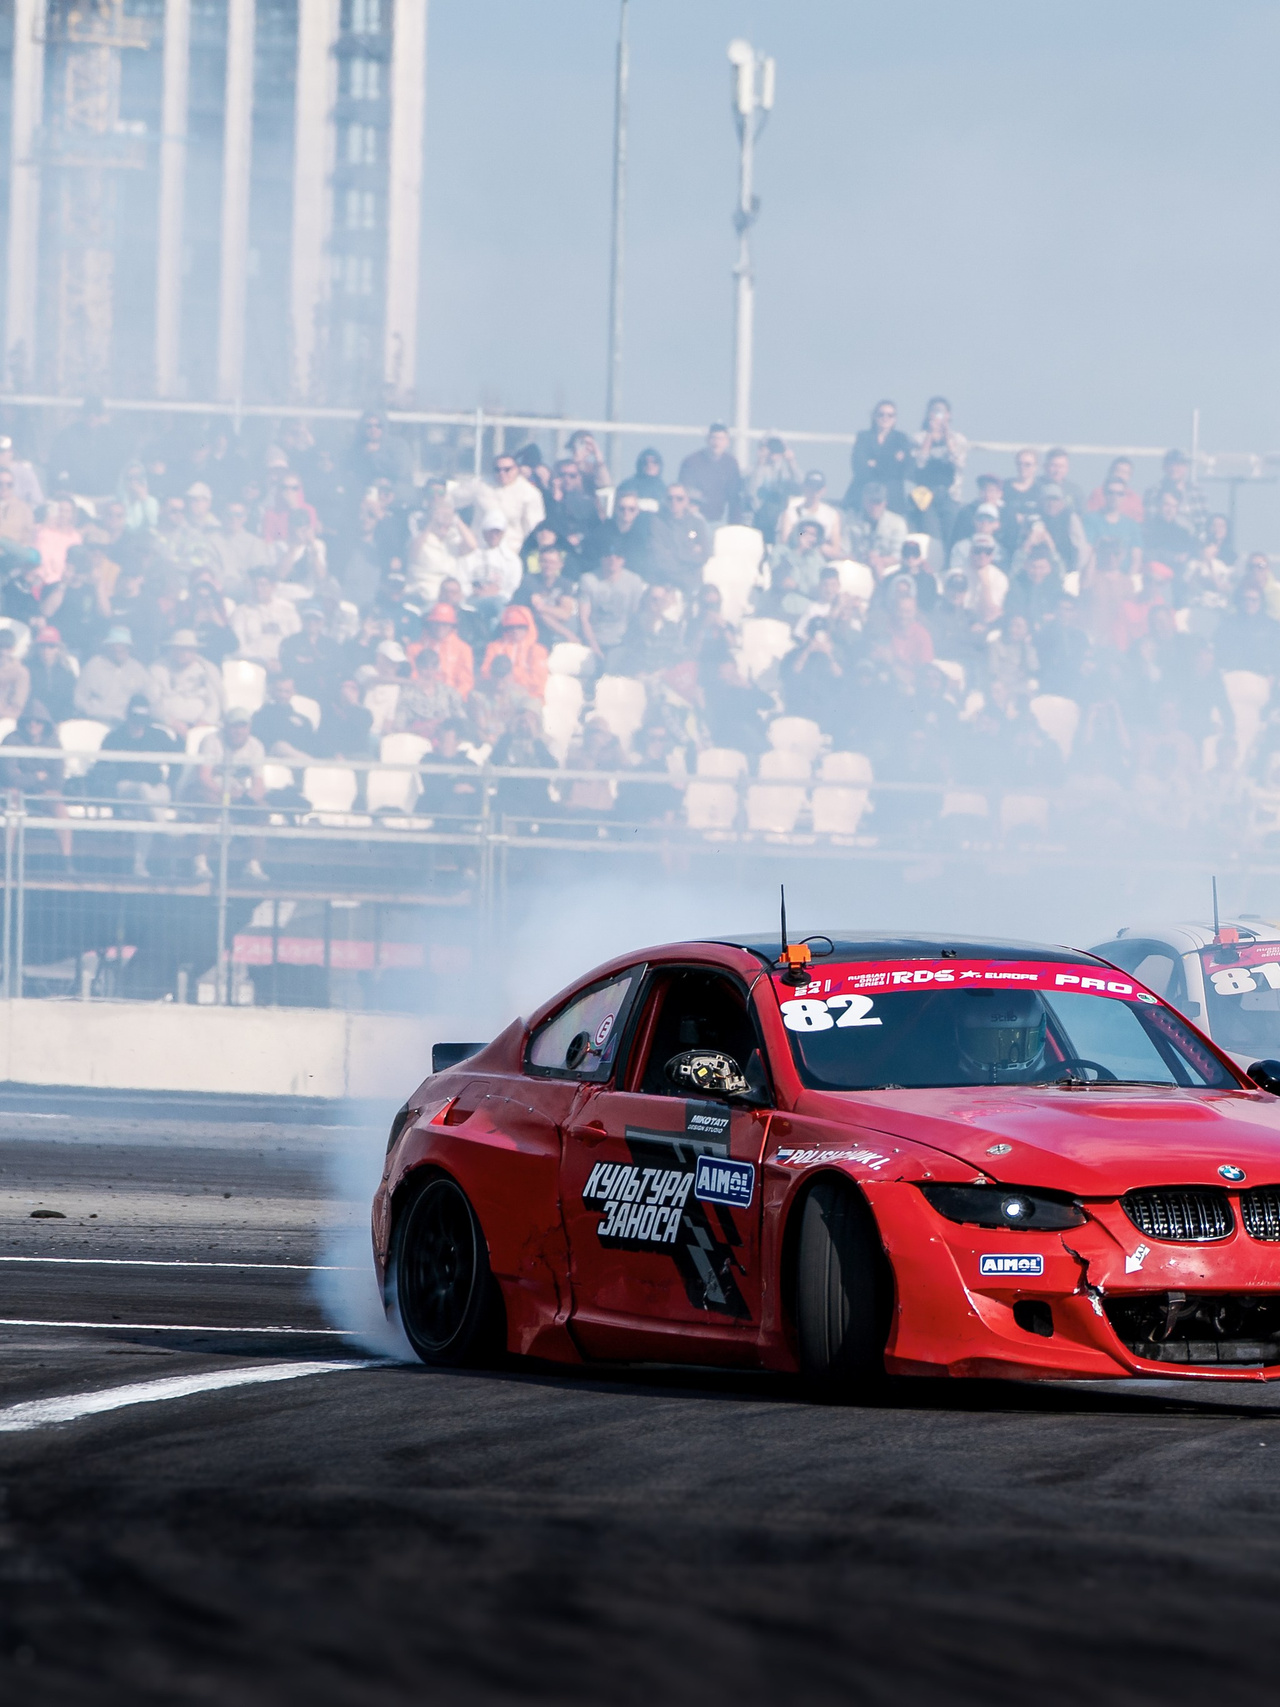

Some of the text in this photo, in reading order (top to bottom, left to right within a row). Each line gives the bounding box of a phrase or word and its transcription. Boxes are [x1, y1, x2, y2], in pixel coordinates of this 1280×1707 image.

[847, 972, 886, 981] RUSSIAN
[854, 980, 885, 988] SERIES
[891, 969, 1133, 995] RDS EUROPE PRO
[780, 994, 883, 1032] 82
[704, 1126, 723, 1134] STUDIO
[582, 1162, 695, 1208] КУЛЬТУРА
[697, 1166, 750, 1198] AIMOL
[597, 1200, 683, 1244] ЗАНОСА
[982, 1258, 1041, 1272] AIMOL
